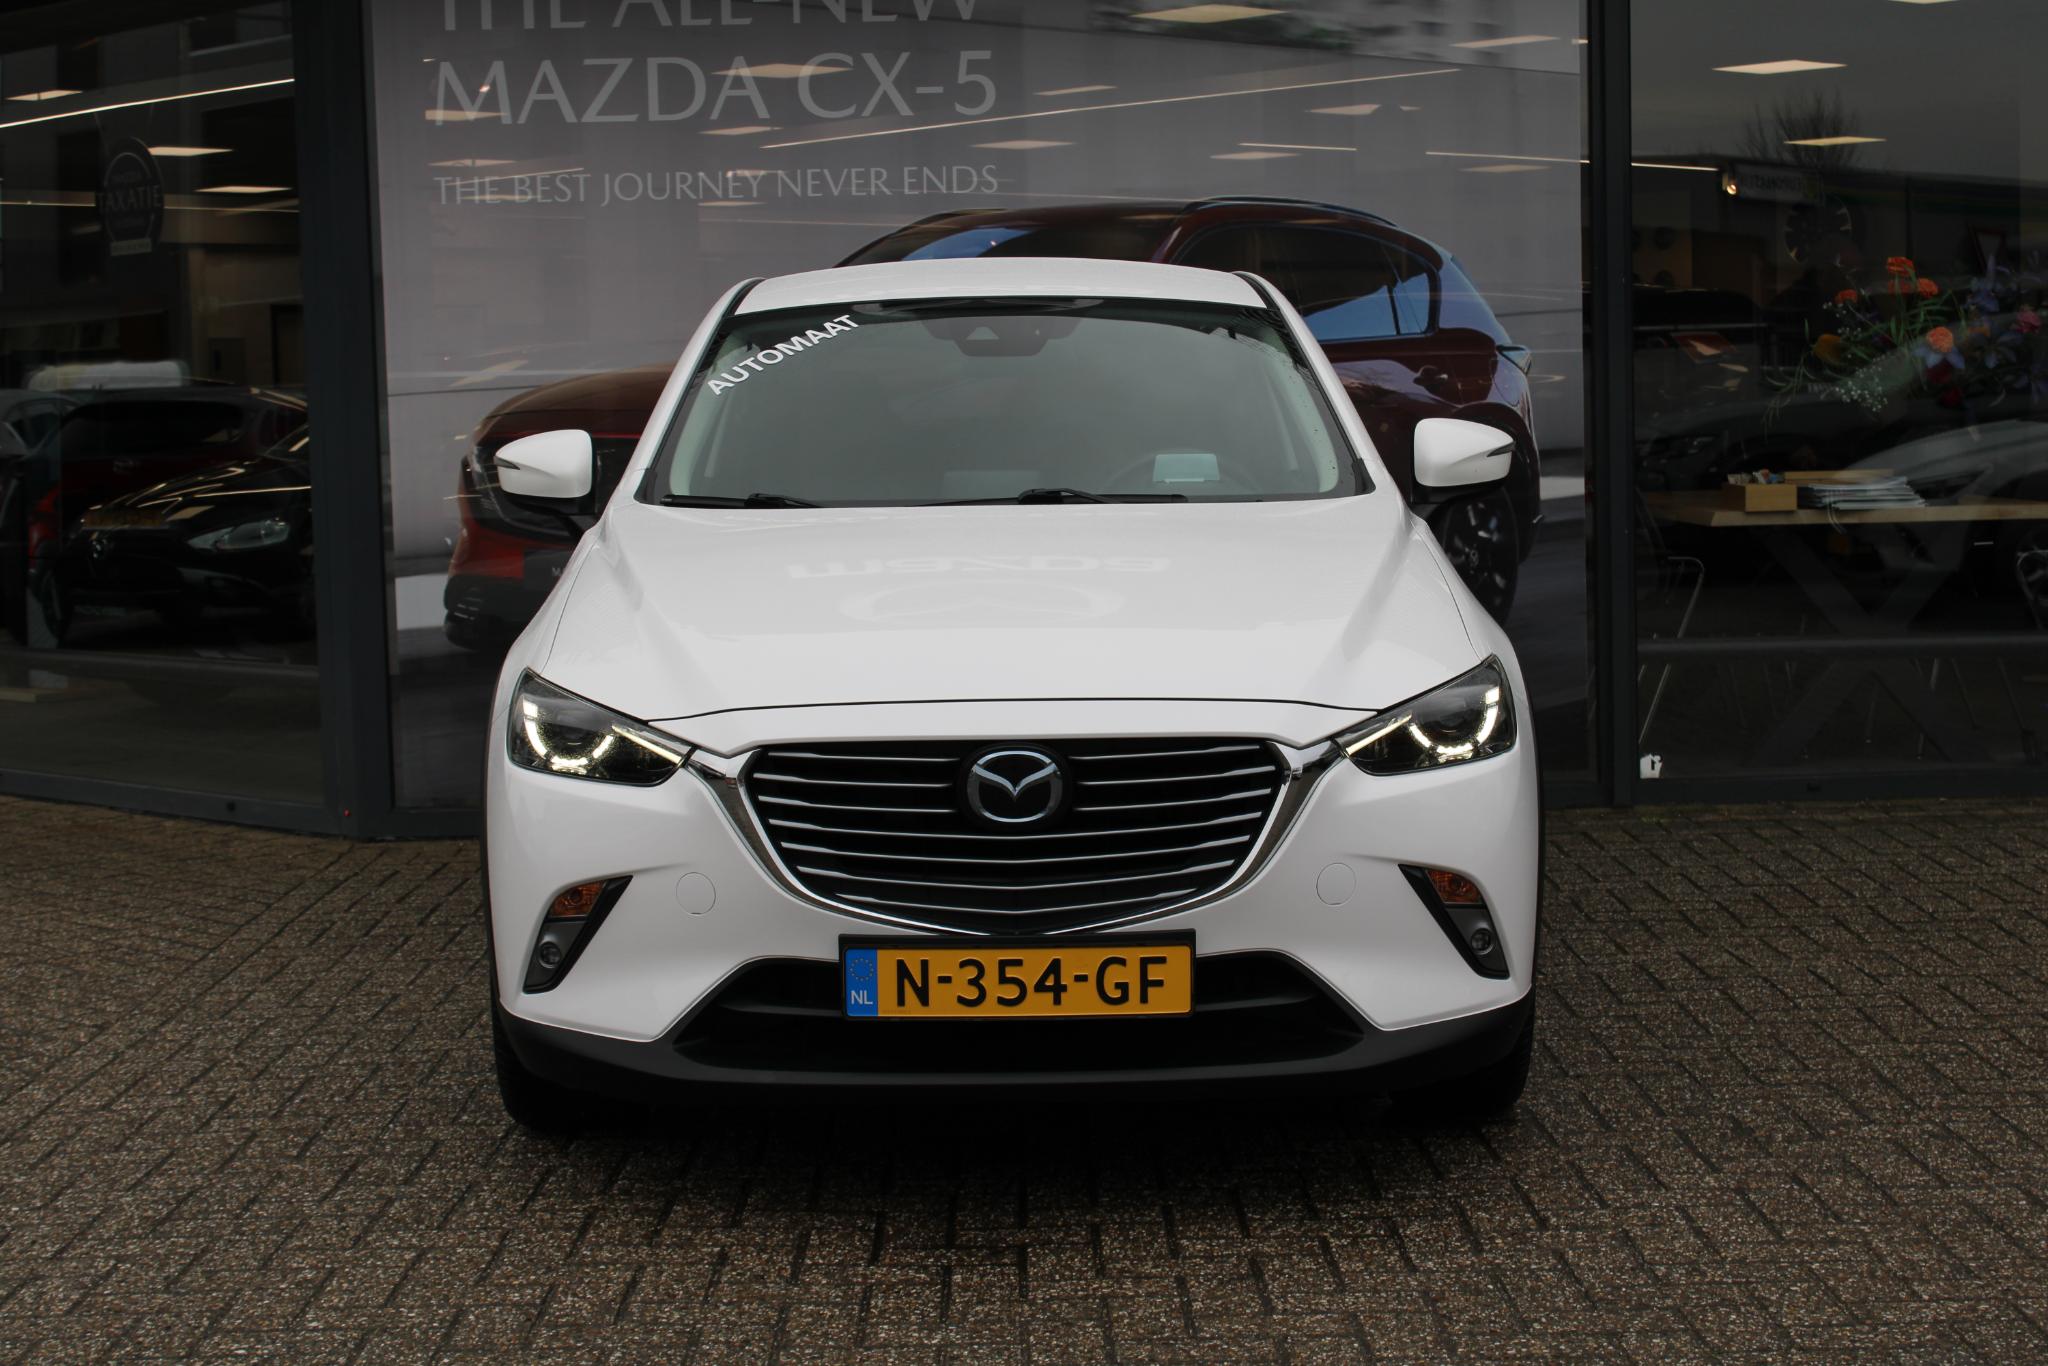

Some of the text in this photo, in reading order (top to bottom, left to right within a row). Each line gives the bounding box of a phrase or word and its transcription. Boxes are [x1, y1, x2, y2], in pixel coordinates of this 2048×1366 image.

[435, 50, 997, 126] MAZDA CX-5
[434, 165, 999, 207] THE BEST JOURNEY NEVER ENDS
[707, 314, 860, 396] AUTOMAAT
[850, 956, 1168, 1007] NL N-354-GF
